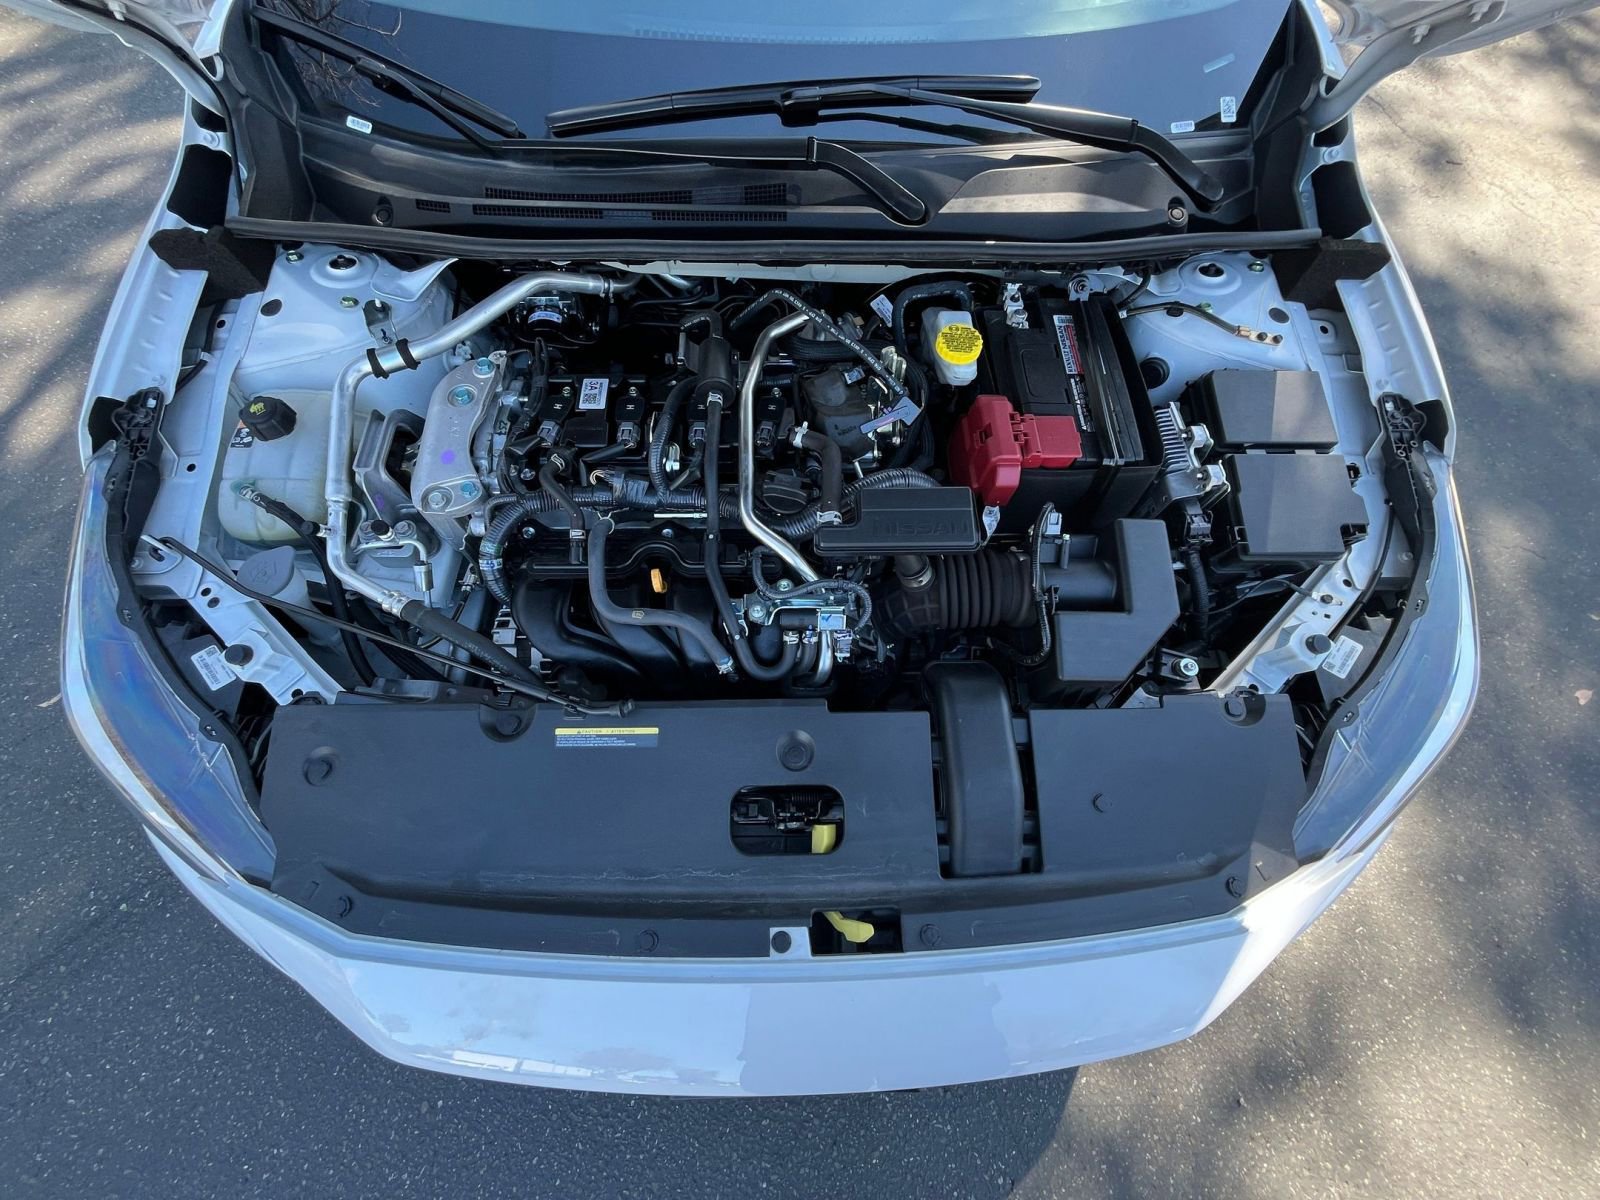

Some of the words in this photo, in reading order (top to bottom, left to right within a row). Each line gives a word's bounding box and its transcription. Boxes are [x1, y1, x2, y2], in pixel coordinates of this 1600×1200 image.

[1057, 325, 1068, 350] NISSAN
[589, 381, 599, 391] 3A
[873, 520, 970, 536] NISSAN
